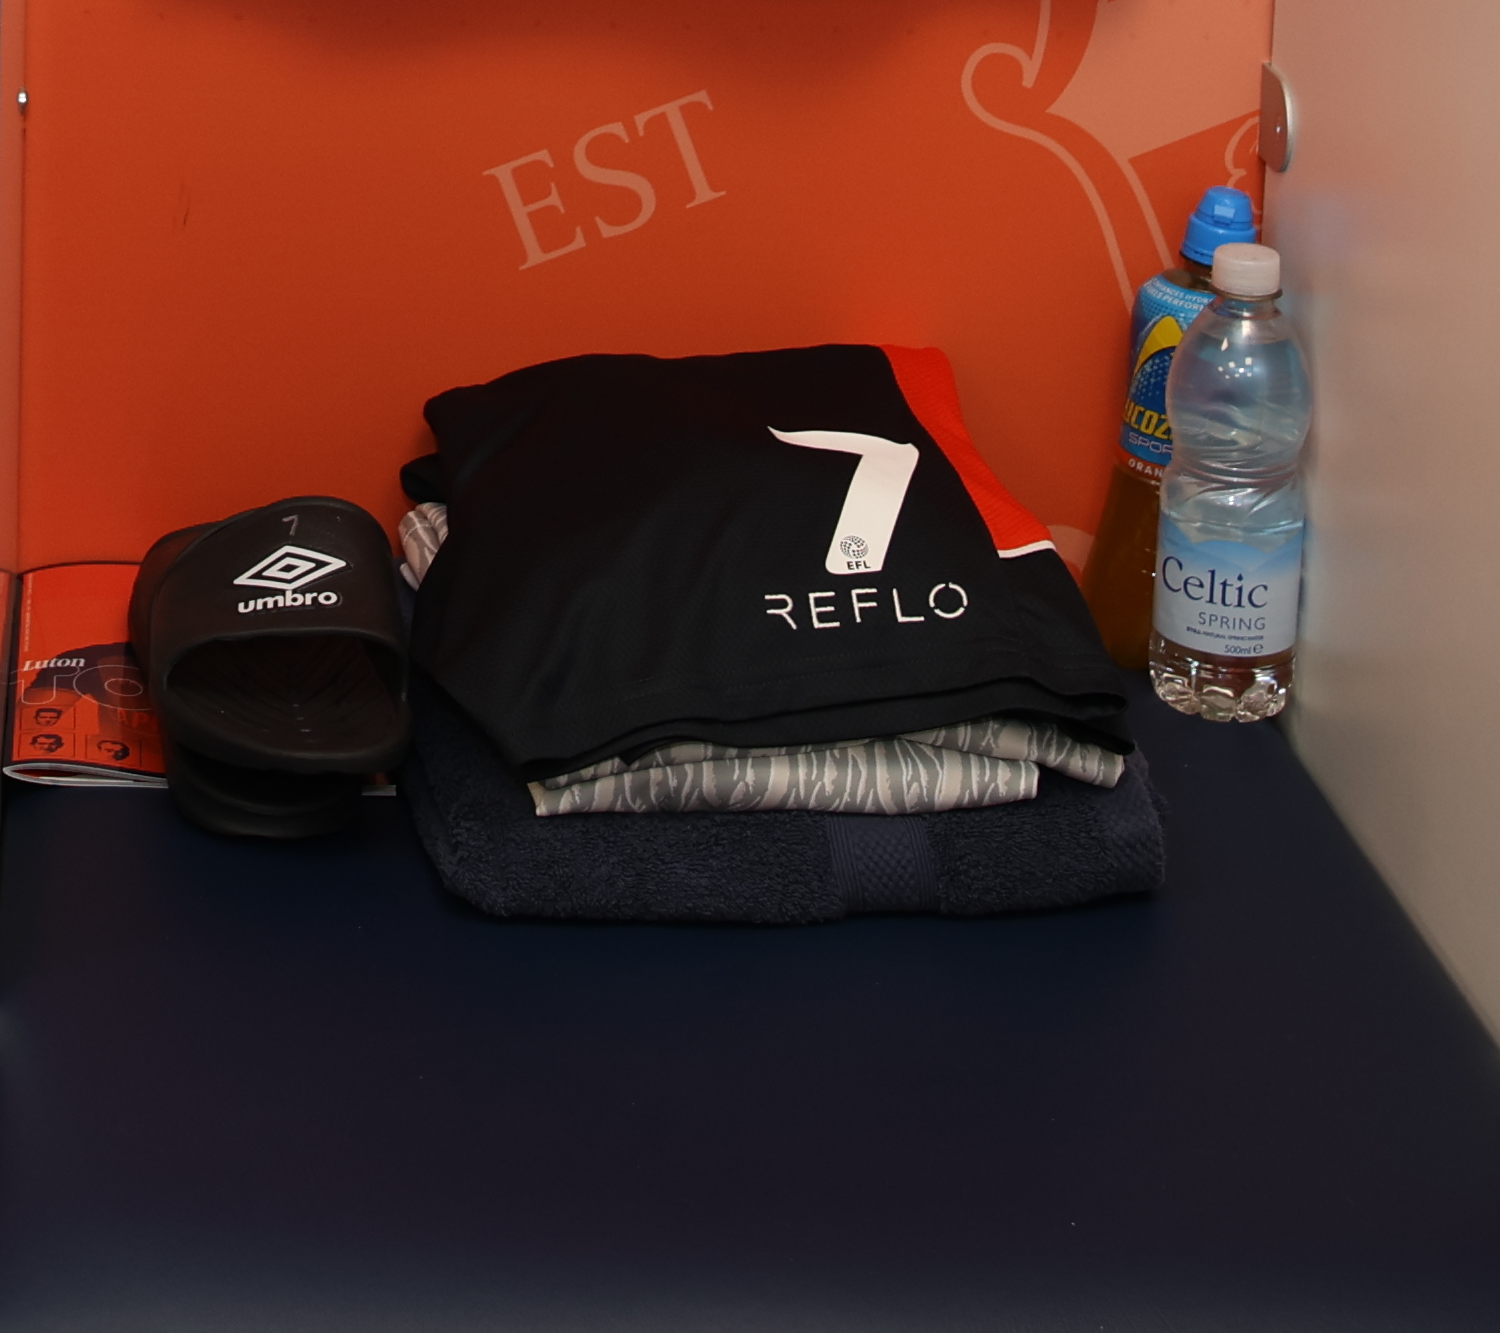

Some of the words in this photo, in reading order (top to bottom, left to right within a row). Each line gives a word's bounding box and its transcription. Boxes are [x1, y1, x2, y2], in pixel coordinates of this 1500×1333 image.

[483, 89, 727, 273] EST
[767, 425, 920, 575] 7
[846, 560, 871, 571] EFL
[1162, 555, 1269, 609] Celtic
[237, 589, 338, 614] umbro
[764, 582, 968, 631] REFLO
[1198, 611, 1267, 631] SPRING
[22, 657, 86, 672] Luton
